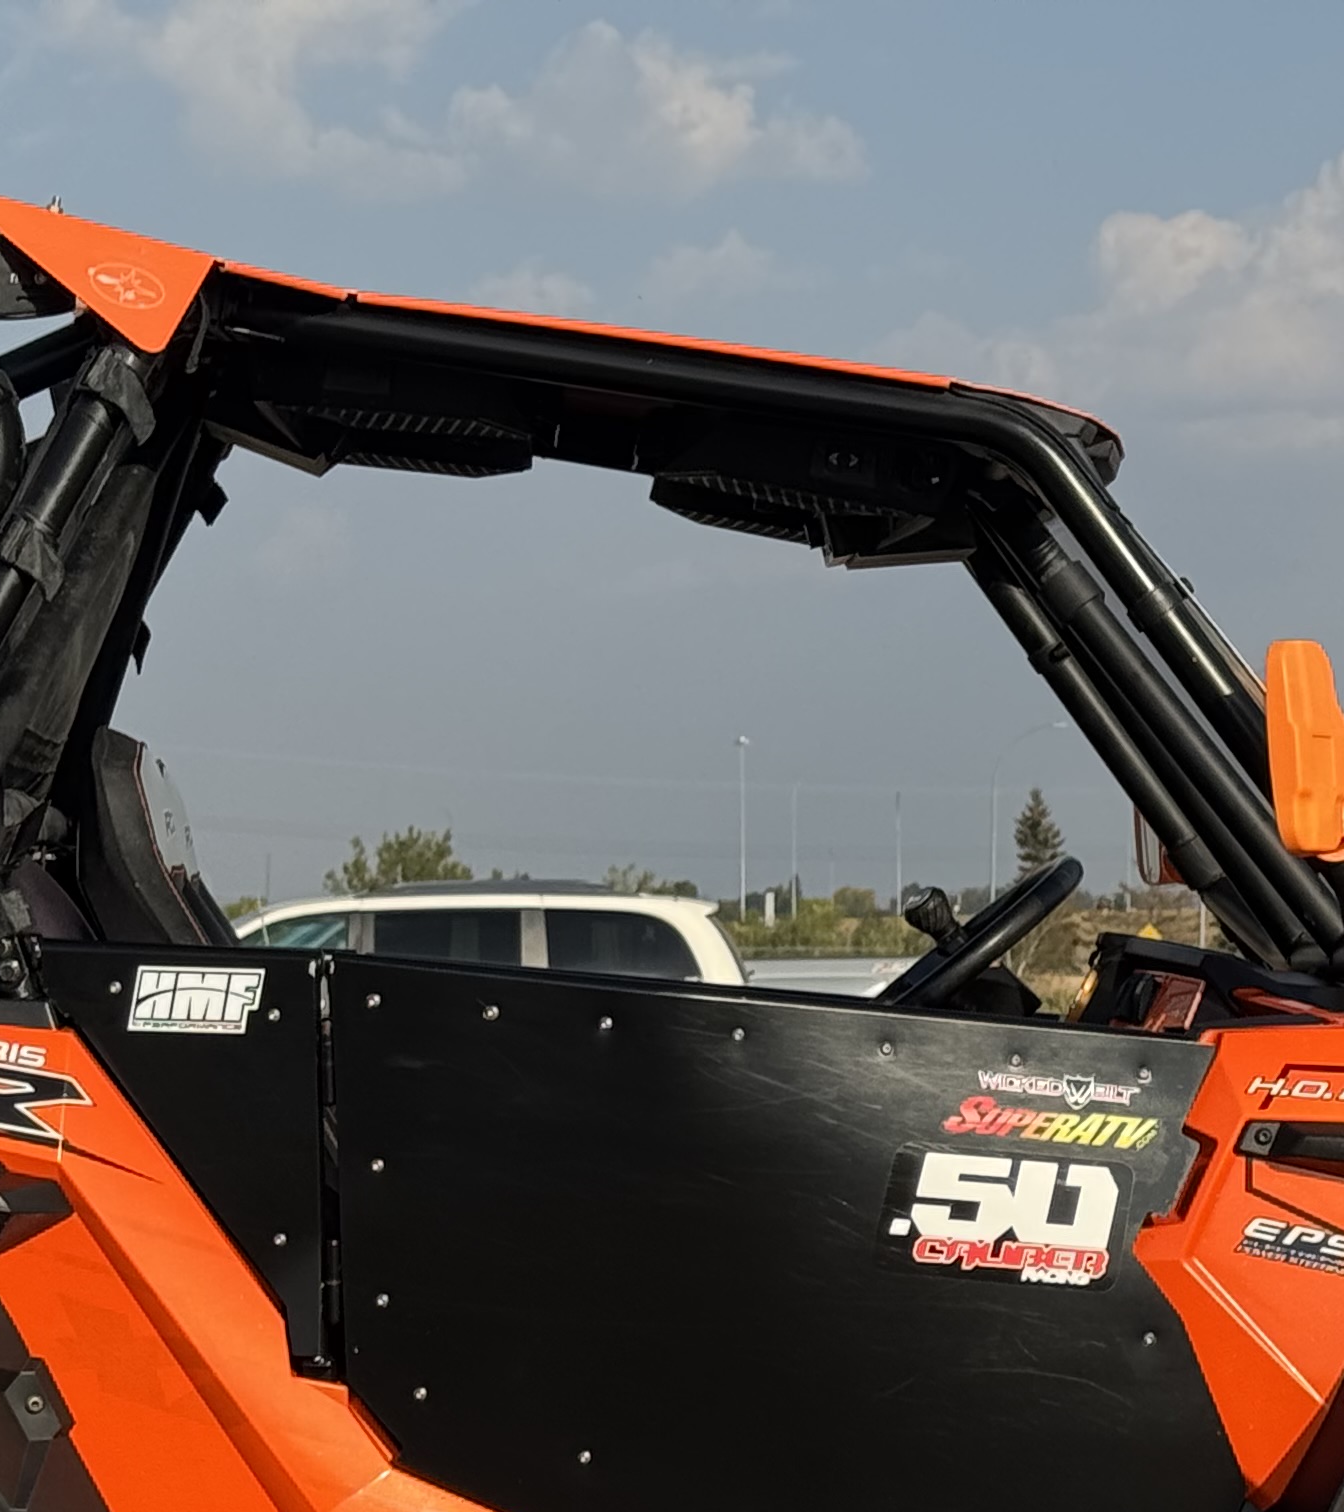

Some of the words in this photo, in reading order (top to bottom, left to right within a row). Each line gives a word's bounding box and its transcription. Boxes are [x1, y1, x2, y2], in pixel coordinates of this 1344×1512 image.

[133, 970, 262, 1022] HMF
[978, 1070, 1065, 1098] WICKED
[1247, 1075, 1333, 1101] H.O.
[889, 1152, 1119, 1248] .50
[912, 1236, 1109, 1280] CALIBER
[1020, 1269, 1091, 1286] RACING
